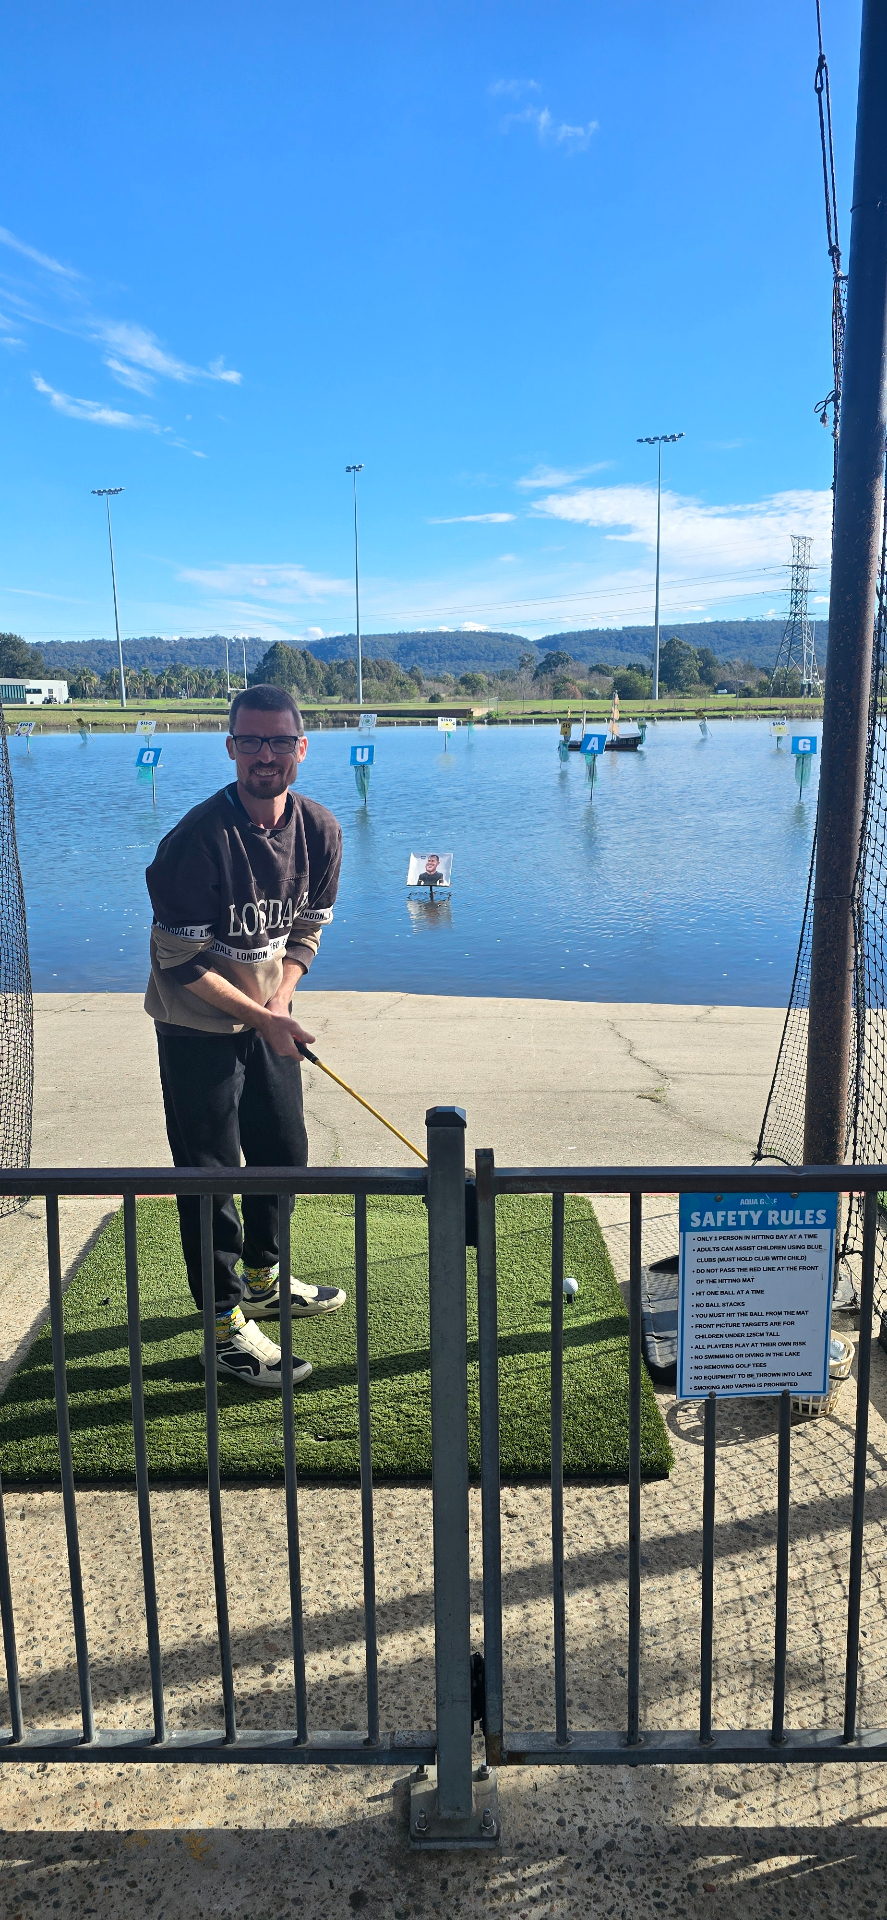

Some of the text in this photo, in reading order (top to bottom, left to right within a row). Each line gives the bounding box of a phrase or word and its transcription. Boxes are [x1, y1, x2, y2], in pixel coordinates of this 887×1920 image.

[587, 737, 599, 751] A
[798, 739, 811, 751] G
[142, 750, 155, 764] Q
[356, 748, 369, 762] U
[236, 950, 268, 961] LONDON
[691, 1210, 826, 1227] SAFETY RULES
